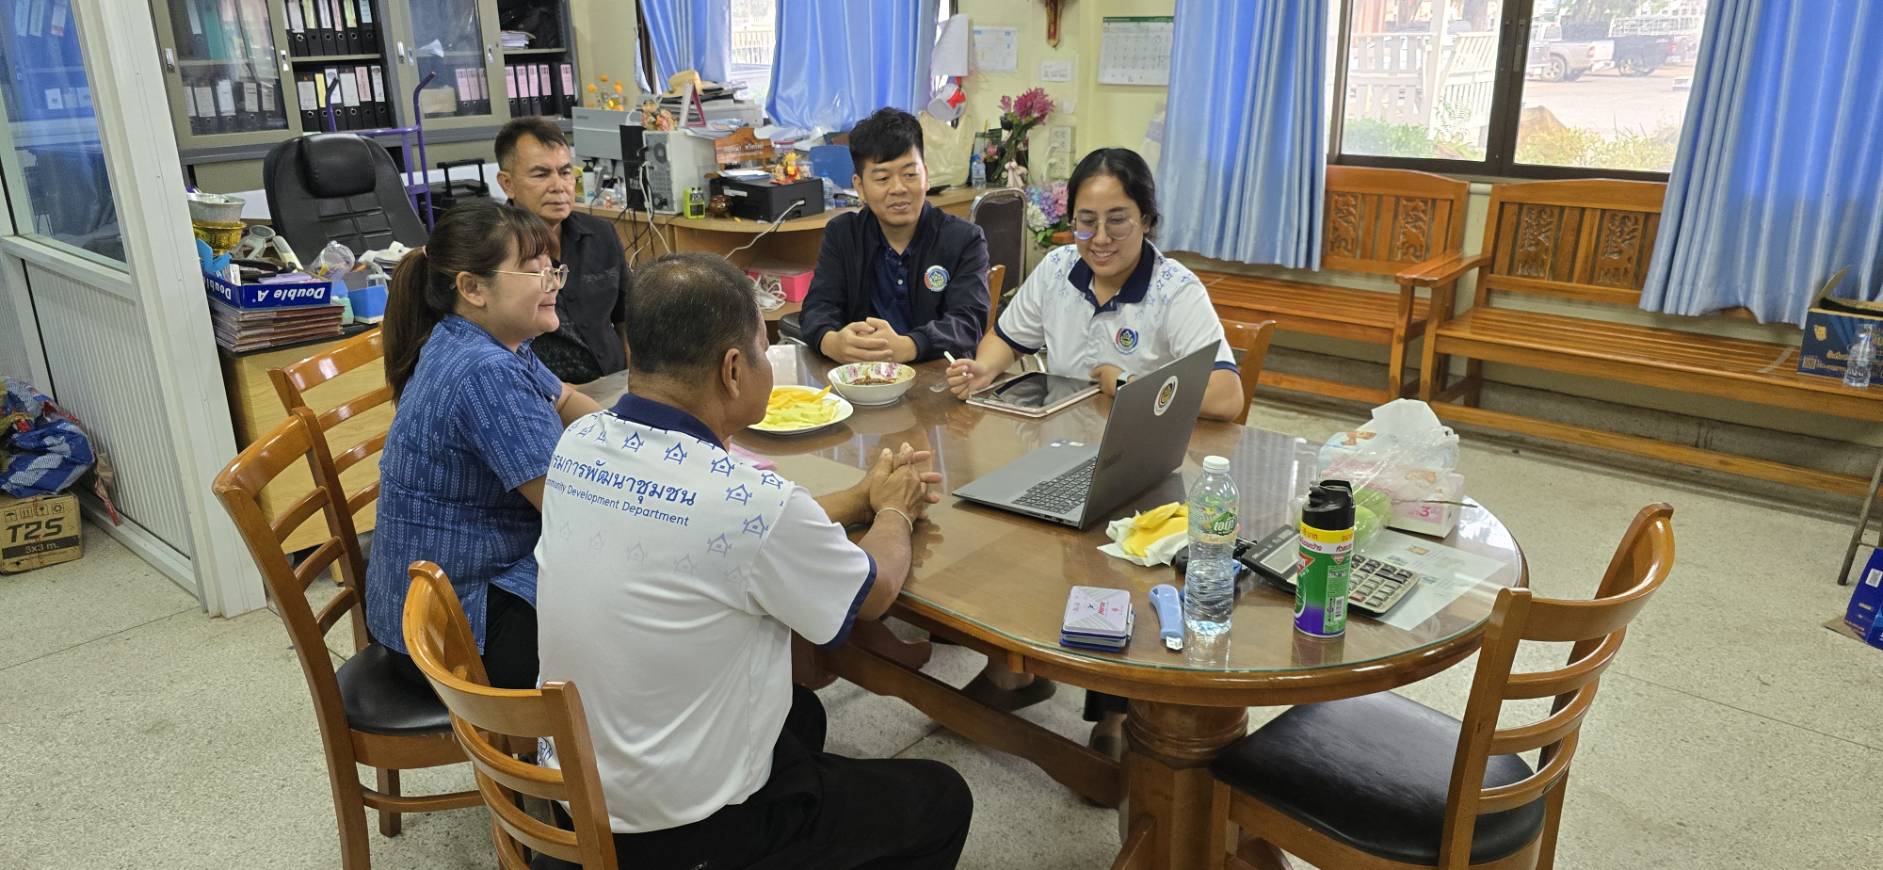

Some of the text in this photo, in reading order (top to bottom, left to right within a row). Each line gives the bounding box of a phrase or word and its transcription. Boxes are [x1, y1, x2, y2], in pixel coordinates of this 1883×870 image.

[206, 278, 232, 300] Doubl
[273, 287, 325, 301] Double
[552, 454, 697, 506] รมการพัฒนาชุมชน
[567, 484, 620, 509] Development
[621, 501, 690, 527] Department
[5, 516, 65, 543] T2S
